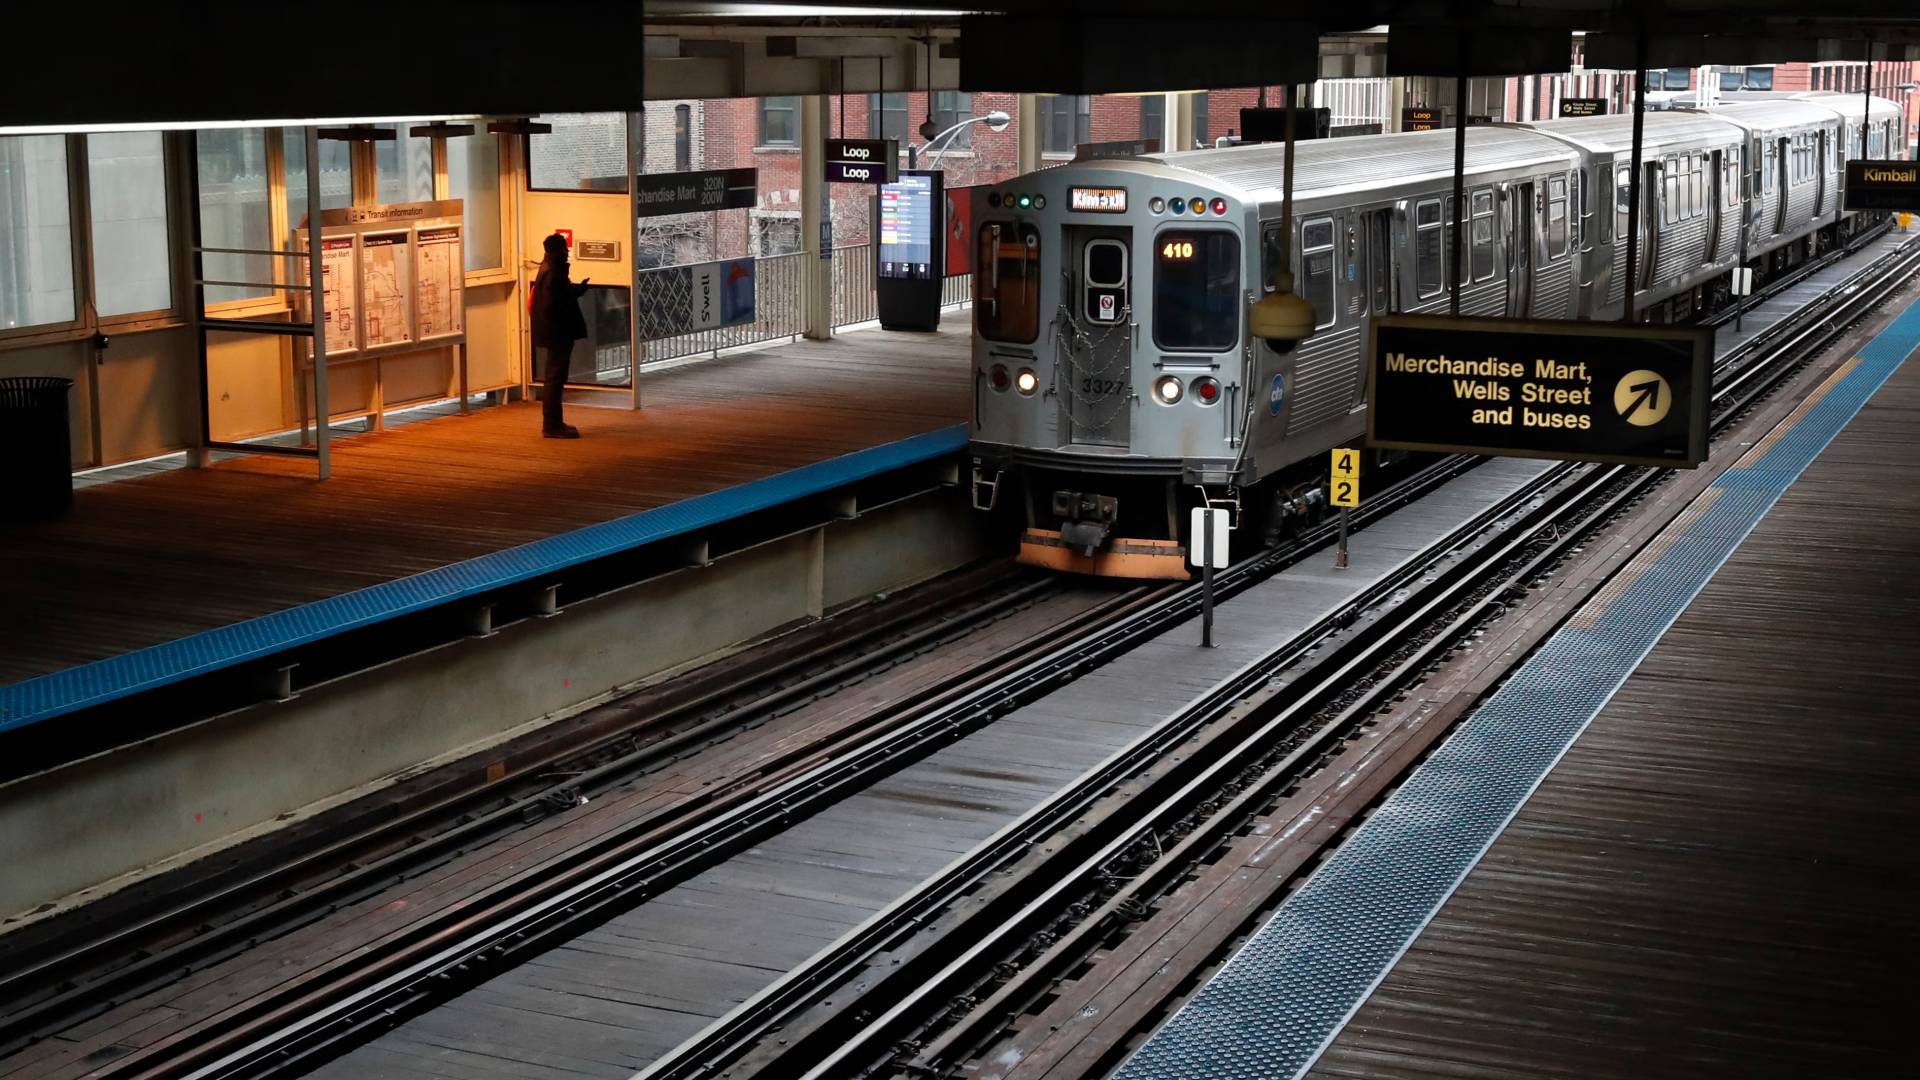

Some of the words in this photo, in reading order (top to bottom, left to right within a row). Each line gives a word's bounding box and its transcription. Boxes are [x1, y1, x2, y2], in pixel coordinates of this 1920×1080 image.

[1413, 111, 1431, 121] Loop
[843, 145, 870, 160] Loop
[843, 165, 870, 181] Loop
[1863, 167, 1917, 183] Kimball
[704, 175, 725, 191] 320N
[677, 184, 696, 201] Mart
[701, 190, 724, 205] 200W
[1163, 243, 1193, 258] 410
[1385, 352, 1525, 378] Merchandise
[1535, 359, 1592, 384] Mart,
[1083, 379, 1124, 395] 3327
[1453, 379, 1510, 401] Wells
[1521, 382, 1592, 405] Street
[1471, 406, 1512, 425] and
[1523, 407, 1592, 430] buses
[1338, 454, 1352, 474] 4
[1337, 482, 1351, 502] 2
